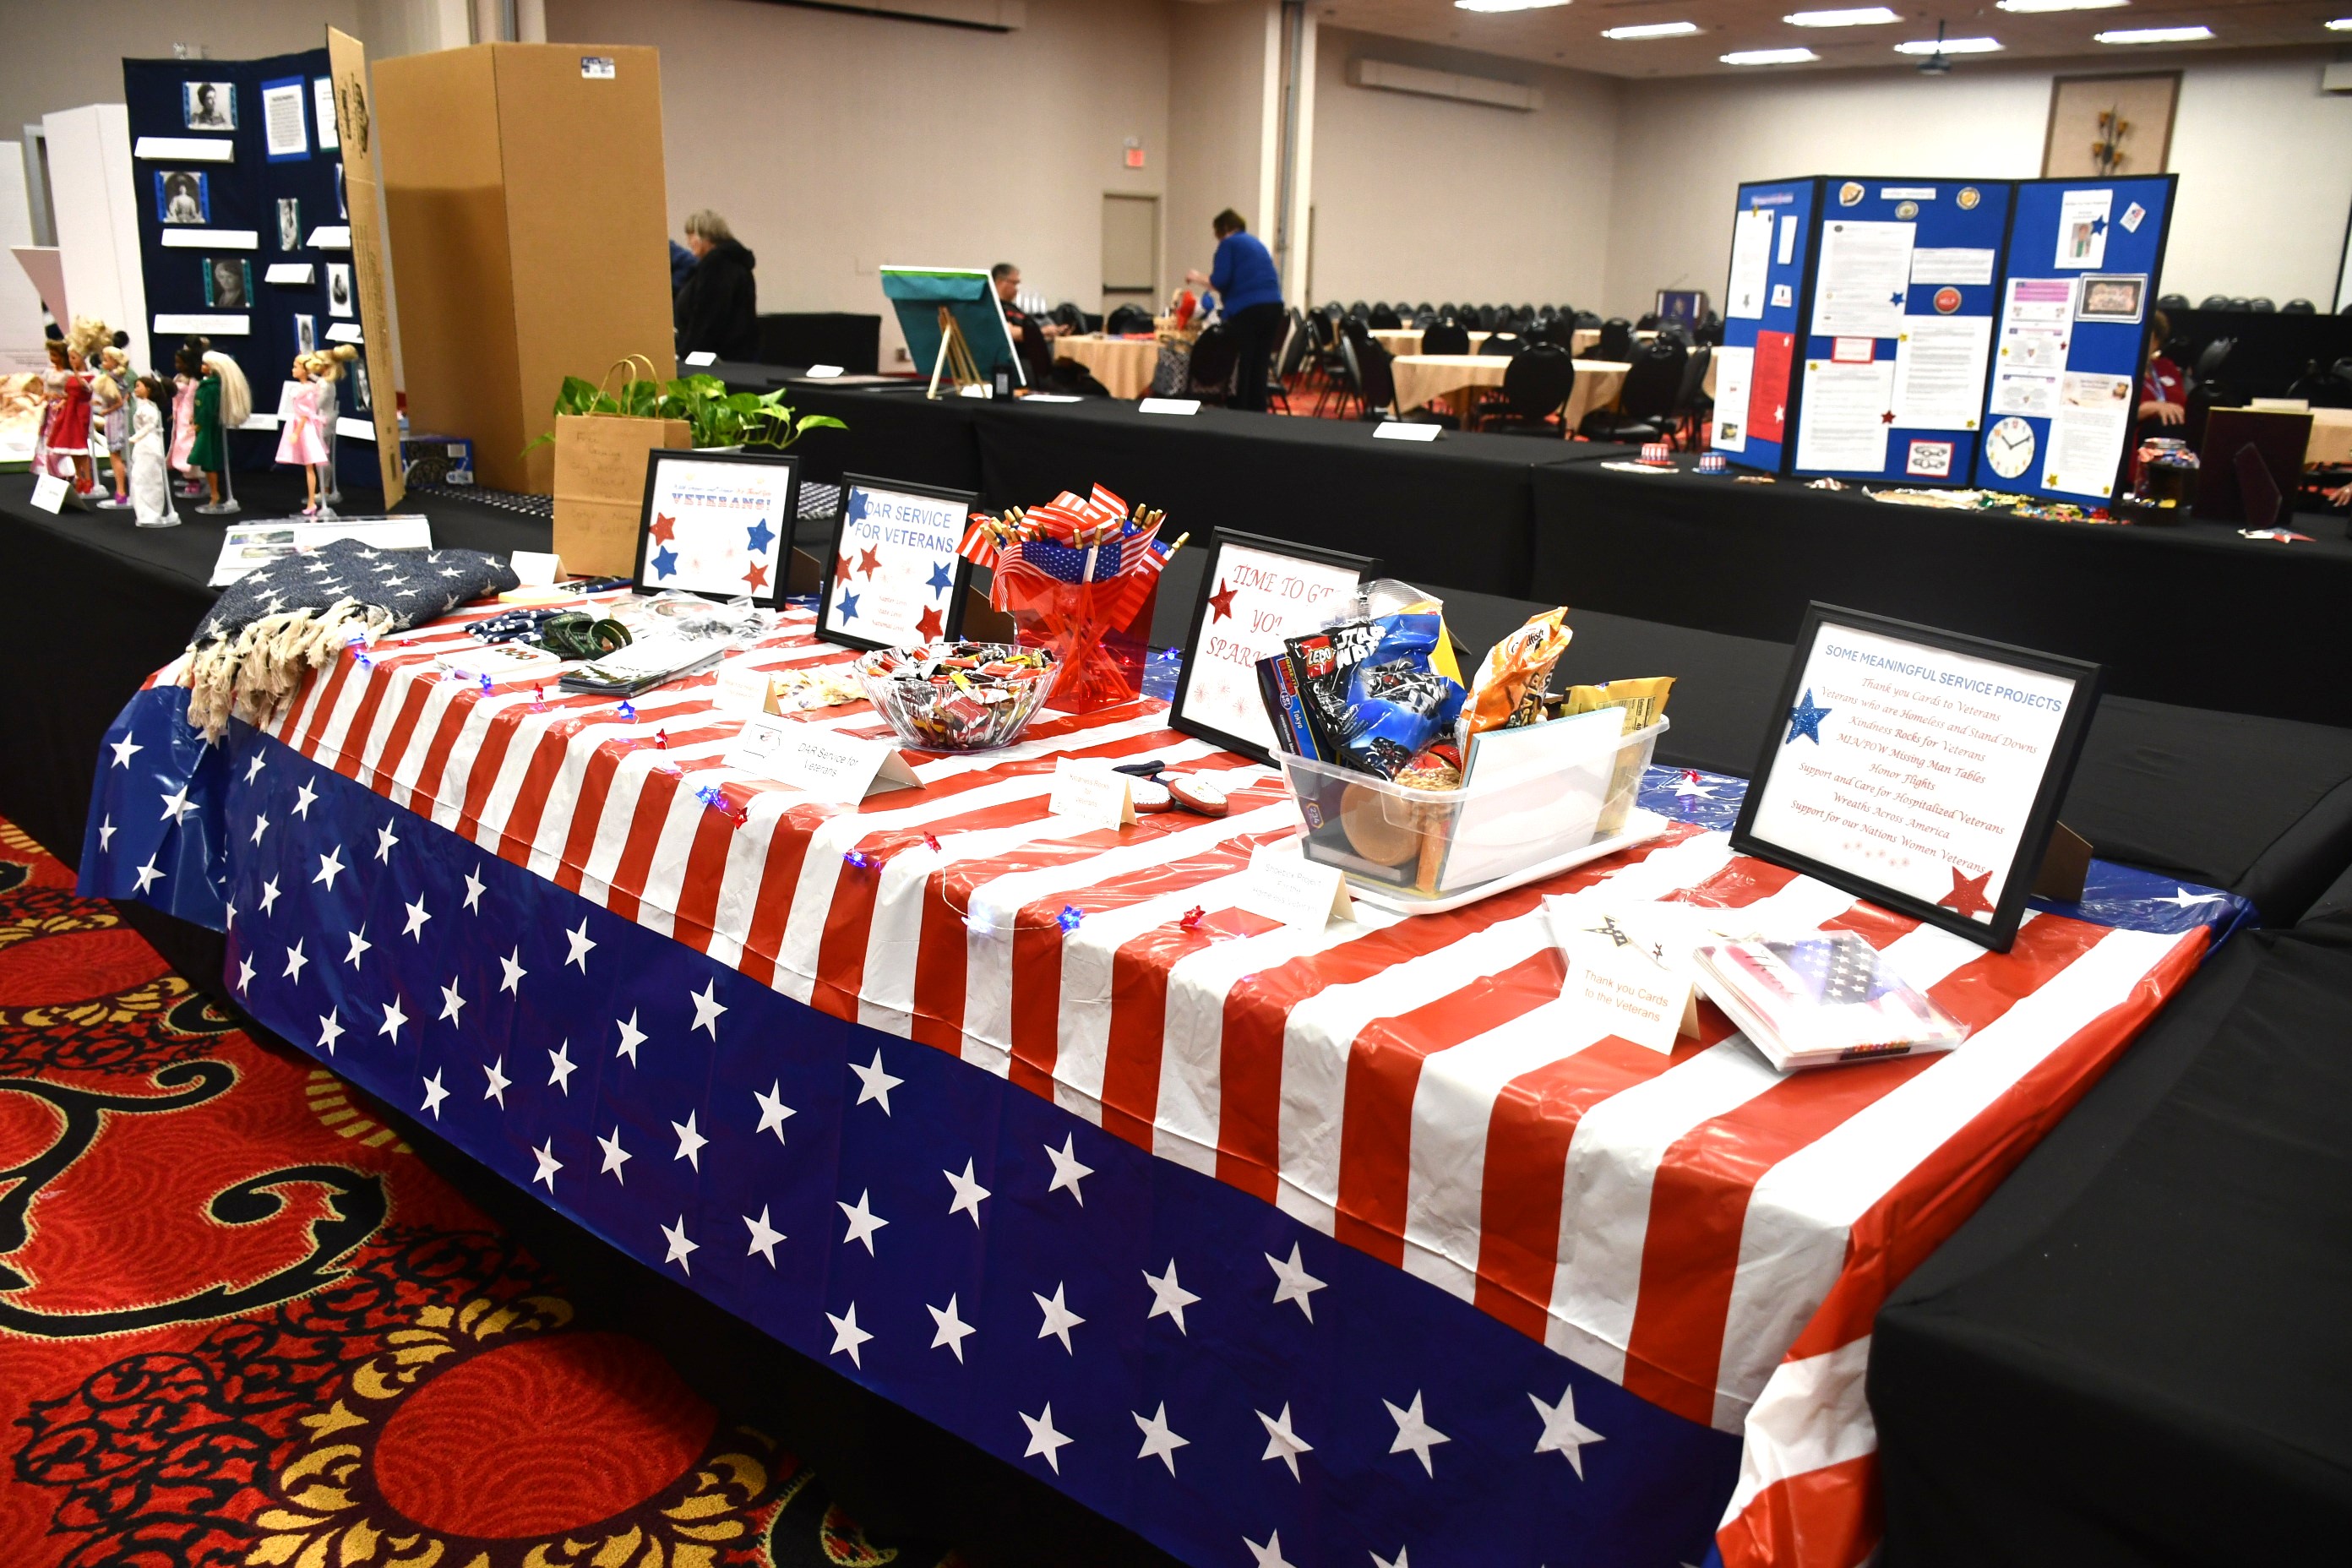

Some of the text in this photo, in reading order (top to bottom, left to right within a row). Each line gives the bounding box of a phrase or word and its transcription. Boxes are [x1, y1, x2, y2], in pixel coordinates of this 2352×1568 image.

[672, 493, 771, 511] VETERANS!
[865, 501, 952, 529] DAR SERVICE
[855, 523, 954, 553] FOR VETERANS
[1233, 564, 1277, 593] TIME
[1281, 576, 1304, 599] TO
[1206, 636, 1266, 668] SPARK
[1337, 626, 1386, 649] STAR
[1511, 629, 1545, 653] dfish
[1337, 642, 1379, 668] WAR
[1285, 657, 1298, 687] MAKE-IT
[1826, 645, 2063, 713] SOME MEANINGFUL SERVICE PROJECTS
[1284, 694, 1293, 707] TOY
[1861, 678, 2001, 722] Thank you Cards to Veterans
[1279, 714, 1292, 743] construction
[1293, 709, 1303, 729] Tokyo
[1821, 686, 2039, 755] Veterans who are Homeless and Stand Downs
[1848, 716, 1986, 762] Kindness Rocks for Veterans
[798, 743, 859, 766] DAR Service for
[803, 759, 838, 777] Veterans
[1836, 732, 1986, 784] MIA/POW Missing Man Tables
[1869, 763, 1936, 792] Honor Flights
[1798, 762, 2006, 835] Support and Care for Hospitalized Veterans
[1833, 792, 1951, 839] Wreaths Across America
[1790, 799, 1987, 874] Support for our Nations Women Veterans
[1585, 970, 1669, 1007] Thank you Cards
[1585, 988, 1661, 1022] to the Veterans
